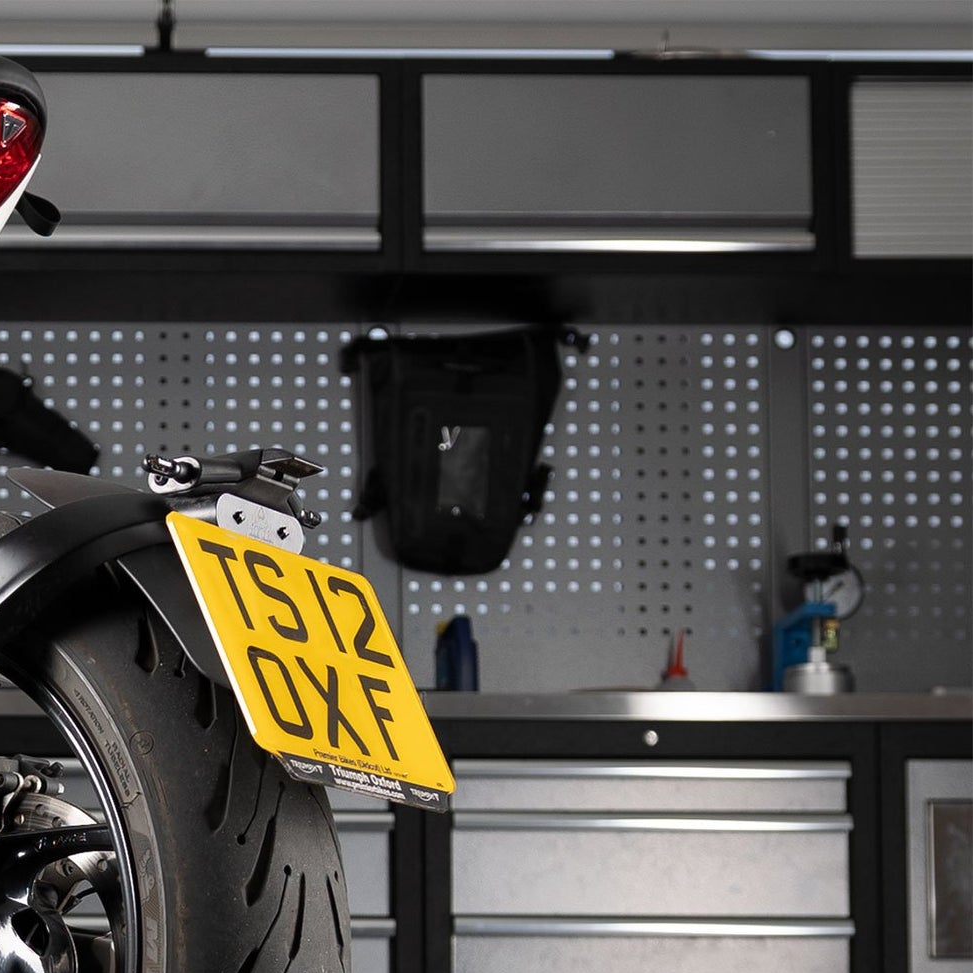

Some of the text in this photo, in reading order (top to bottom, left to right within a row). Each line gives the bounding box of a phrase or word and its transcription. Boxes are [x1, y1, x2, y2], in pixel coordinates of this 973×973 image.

[247, 645, 400, 761] OXF
[328, 764, 402, 791] Triumph Oxford
